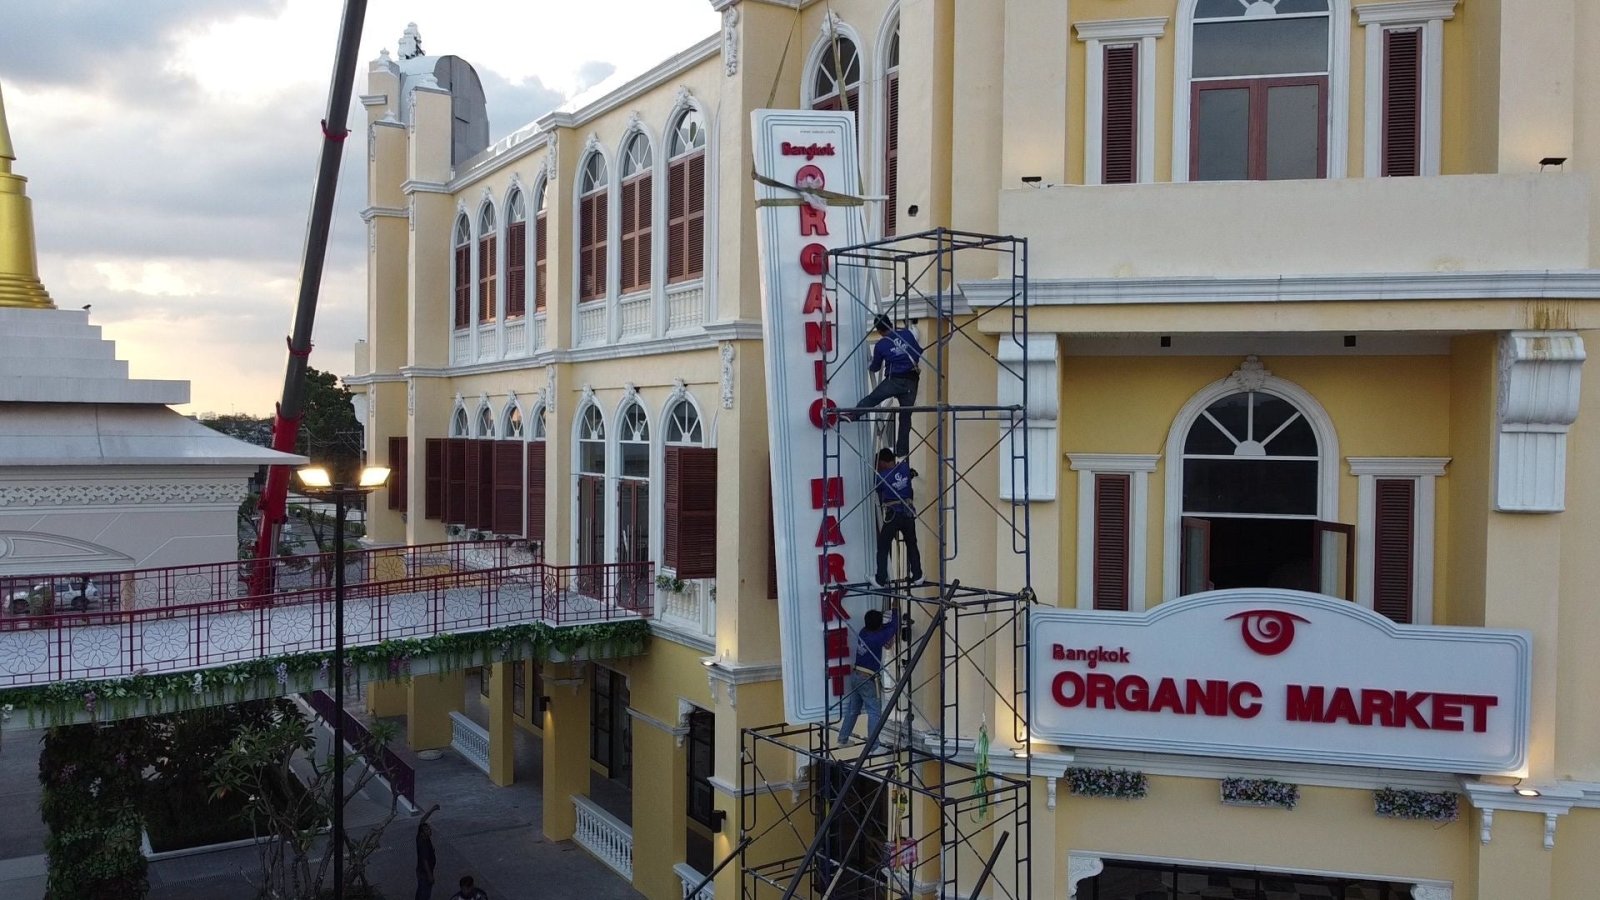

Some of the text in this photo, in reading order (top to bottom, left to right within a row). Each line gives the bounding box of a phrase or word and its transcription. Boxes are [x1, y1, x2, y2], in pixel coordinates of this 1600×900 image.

[781, 142, 835, 161] Bangkok
[810, 476, 851, 696] MARKET
[1052, 643, 1130, 668] Bangkok
[1051, 670, 1498, 732] ORGANIC MARKET
